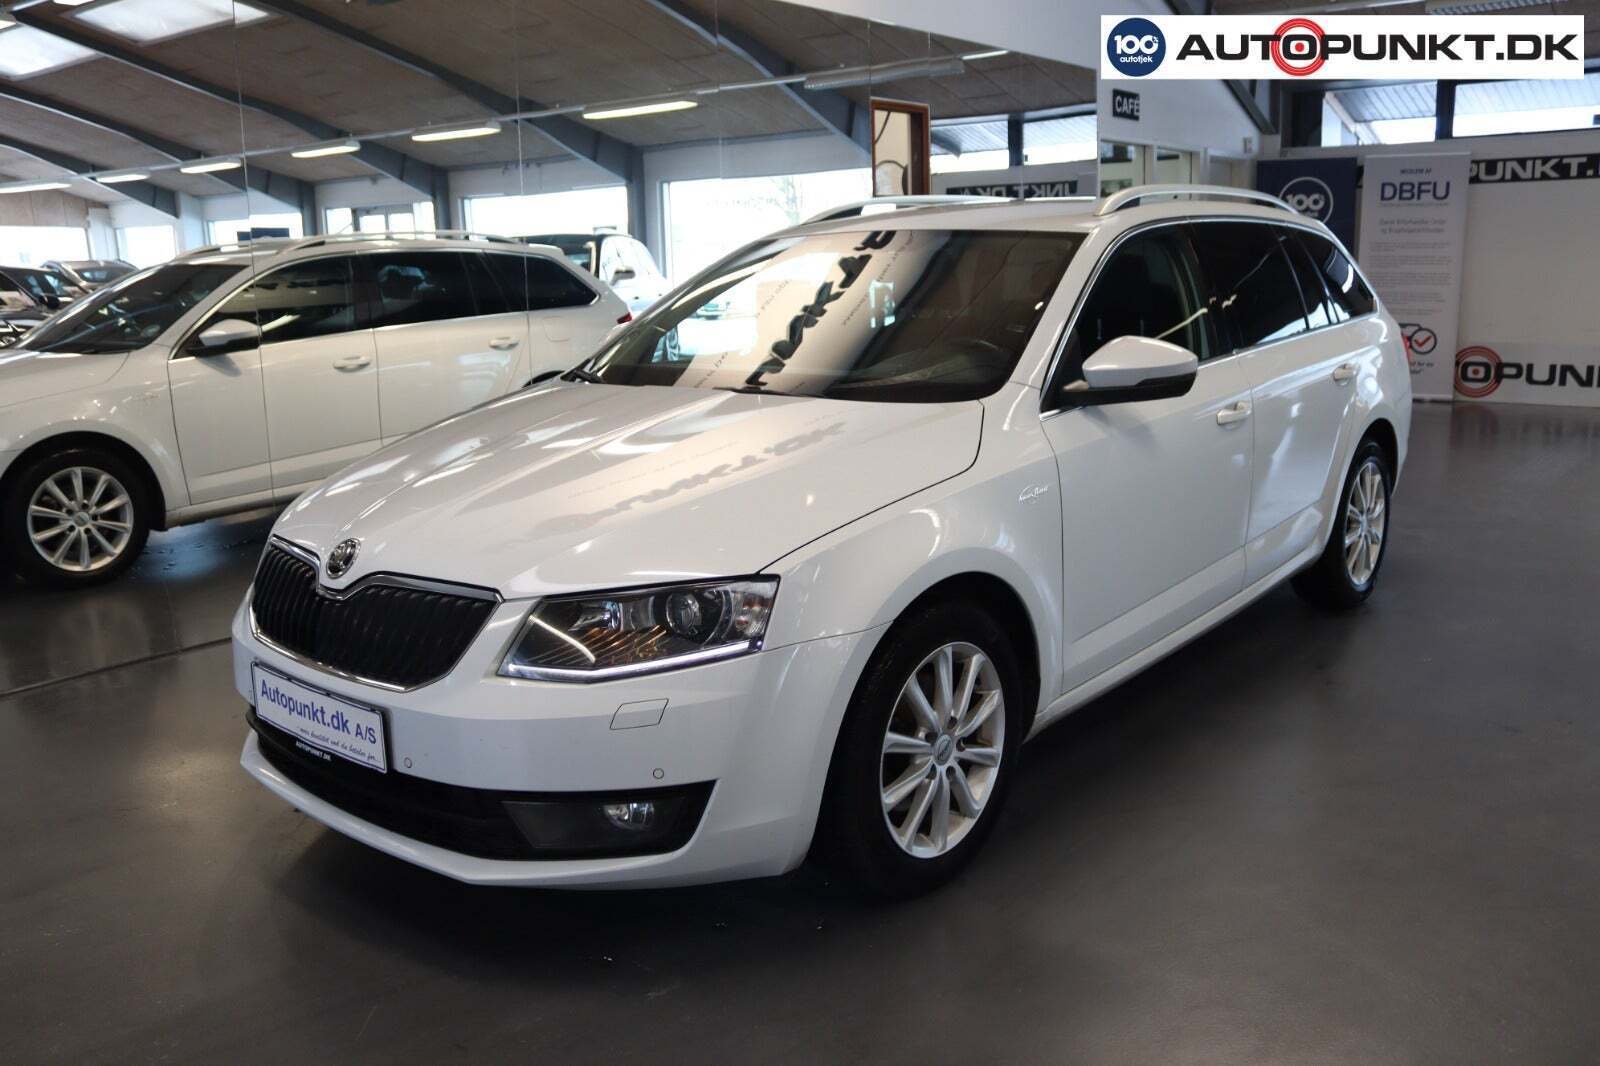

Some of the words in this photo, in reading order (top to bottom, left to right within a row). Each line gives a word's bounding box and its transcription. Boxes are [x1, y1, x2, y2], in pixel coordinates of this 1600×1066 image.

[1470, 156, 1600, 181] UNKT.
[1380, 181, 1451, 201] DBFU
[261, 679, 351, 735] Autopunkt.dk
[355, 723, 377, 745] A/S
